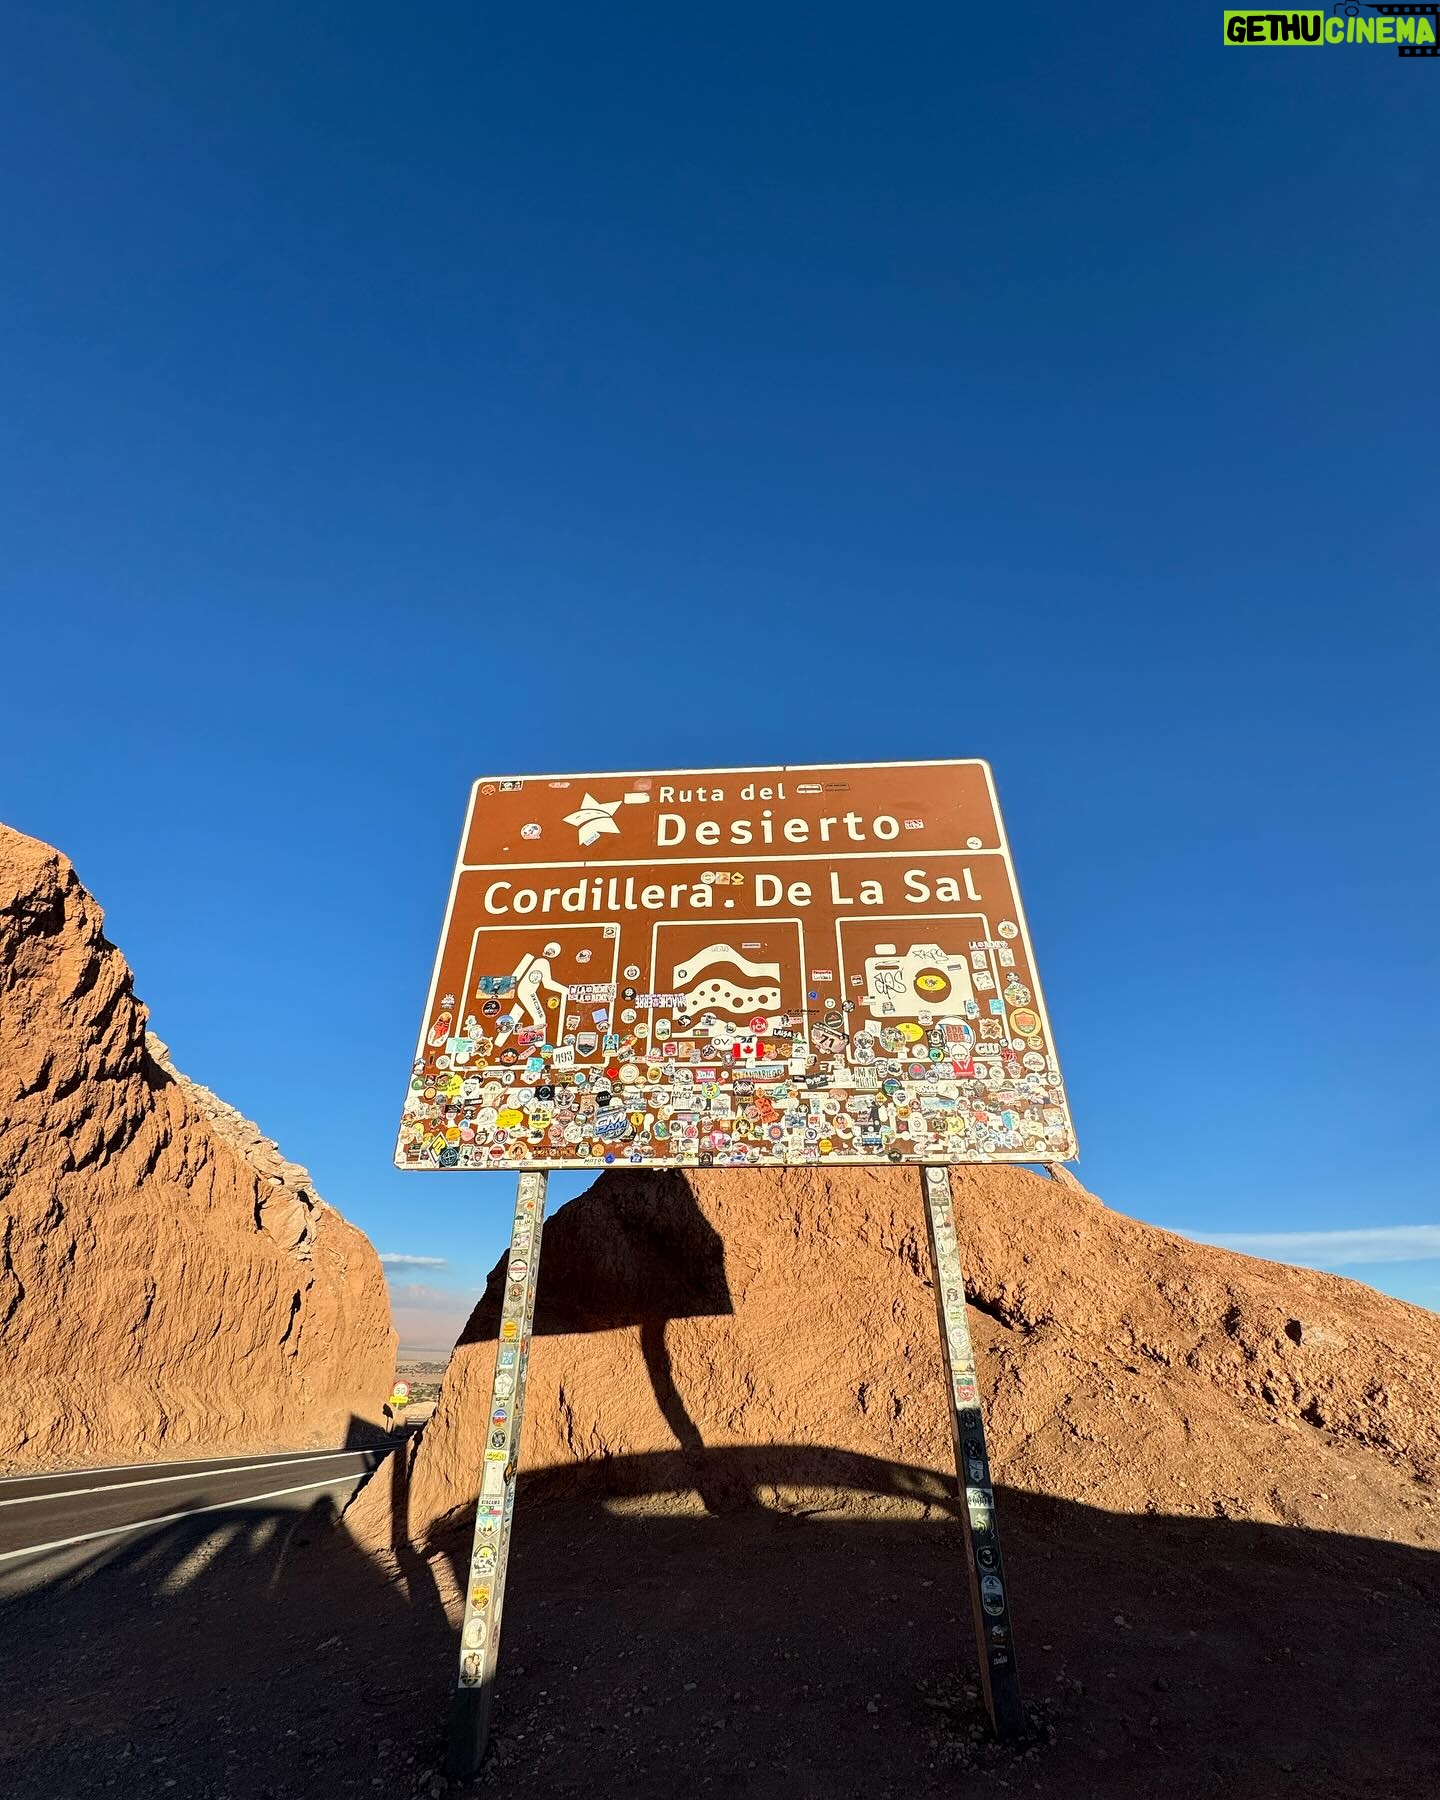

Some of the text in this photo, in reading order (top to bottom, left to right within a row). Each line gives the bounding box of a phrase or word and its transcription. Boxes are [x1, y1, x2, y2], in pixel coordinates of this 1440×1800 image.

[659, 783, 786, 804] Ruta del
[657, 809, 900, 847] Desierto
[755, 874, 812, 907] De
[830, 871, 884, 905] La
[903, 867, 982, 904] Sal
